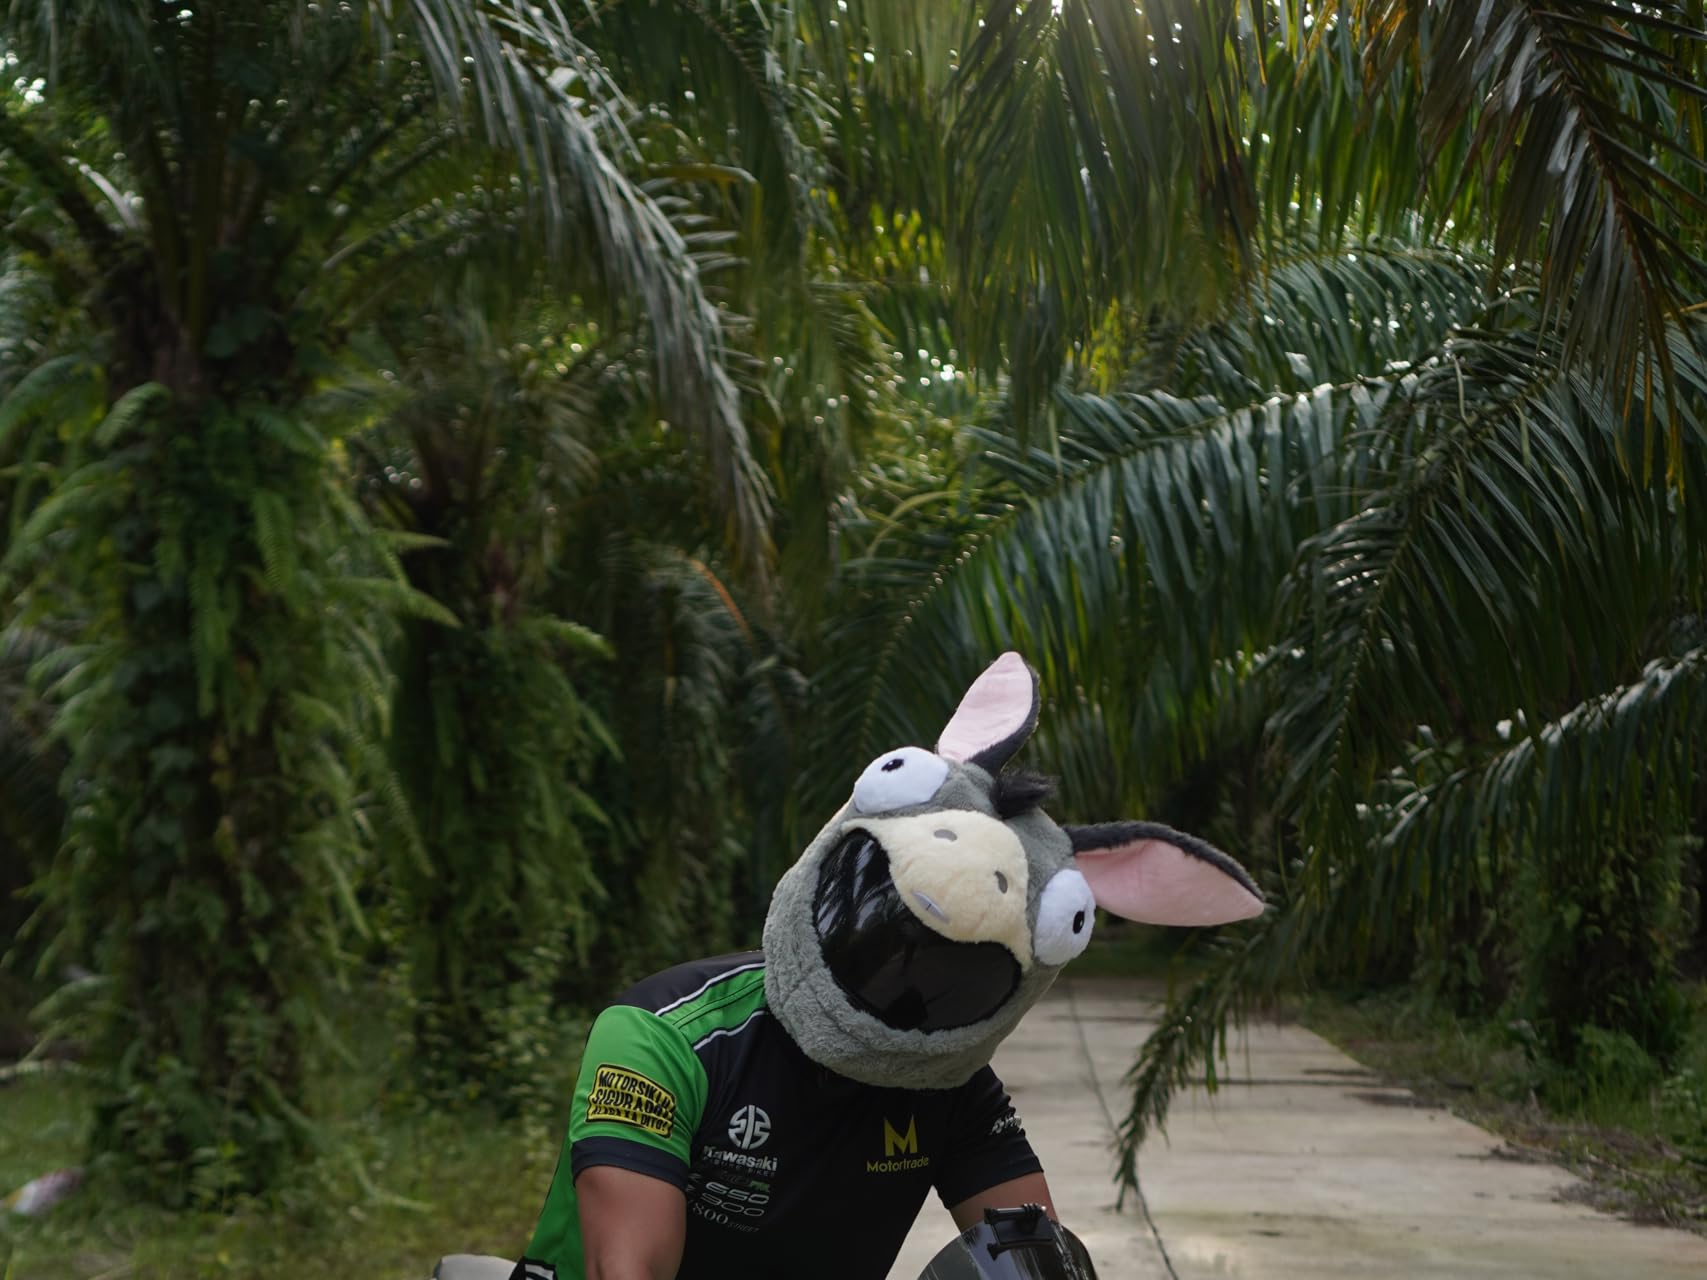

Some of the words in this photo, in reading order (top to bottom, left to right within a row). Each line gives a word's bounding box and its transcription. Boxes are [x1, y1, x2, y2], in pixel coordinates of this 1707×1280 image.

[641, 1114, 668, 1131] DITO!
[703, 1145, 778, 1172] Kawasaki
[866, 1155, 929, 1173] Motortrade
